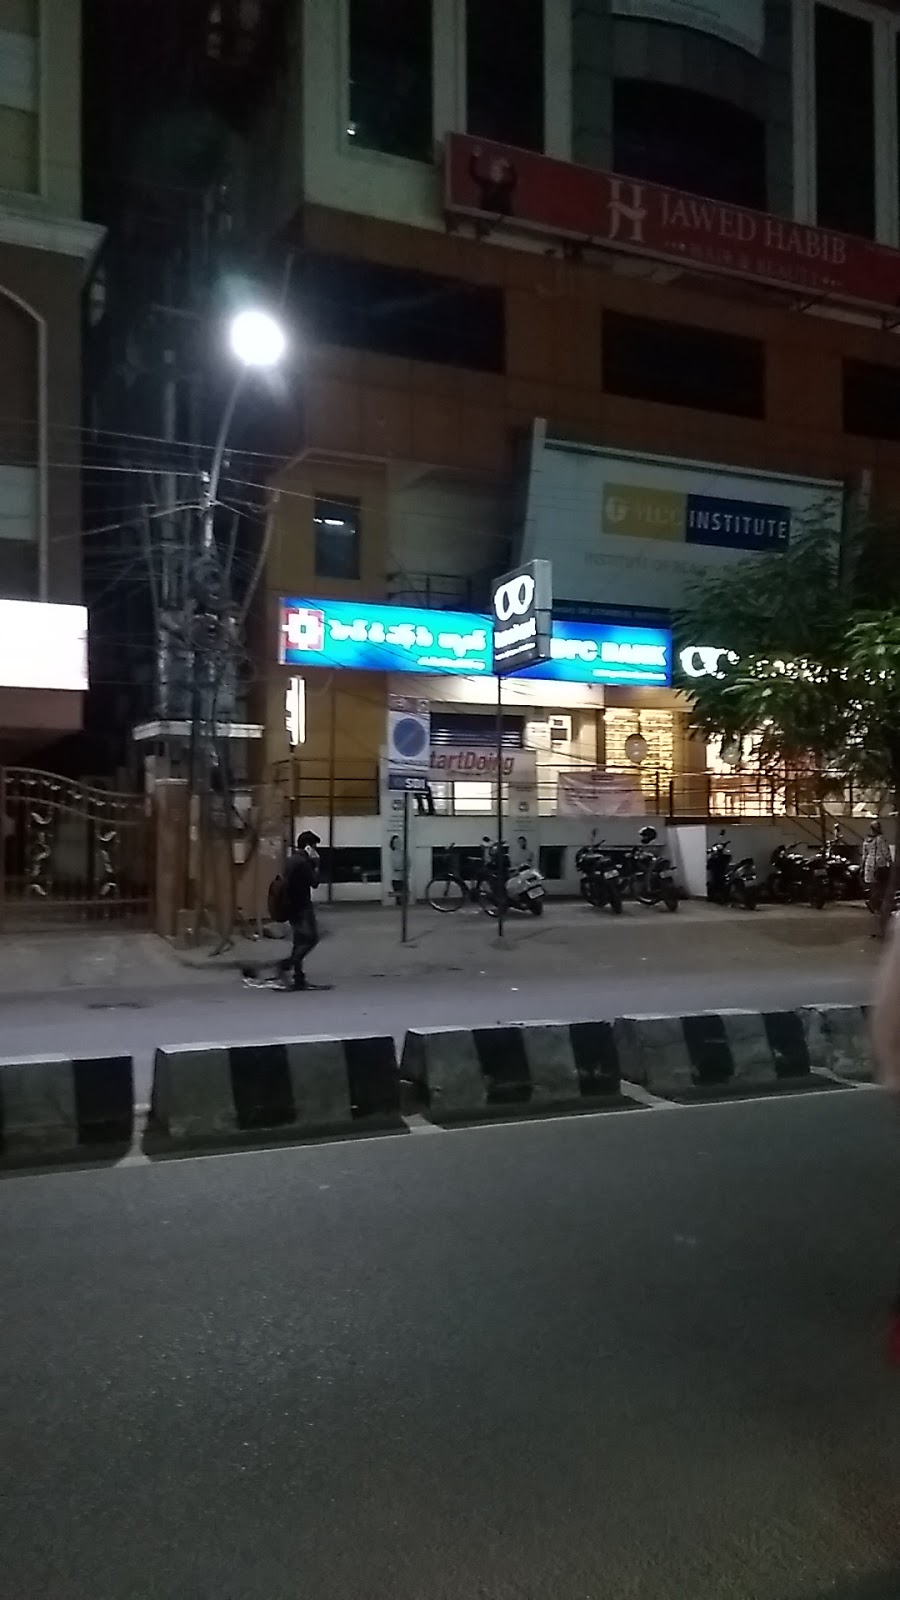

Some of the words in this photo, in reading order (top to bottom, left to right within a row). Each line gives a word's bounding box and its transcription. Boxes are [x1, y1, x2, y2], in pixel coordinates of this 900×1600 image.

[660, 193, 757, 241] JAWED
[764, 219, 848, 265] HABIB
[689, 510, 787, 539] INSTITUTE
[602, 643, 667, 666] BANK
